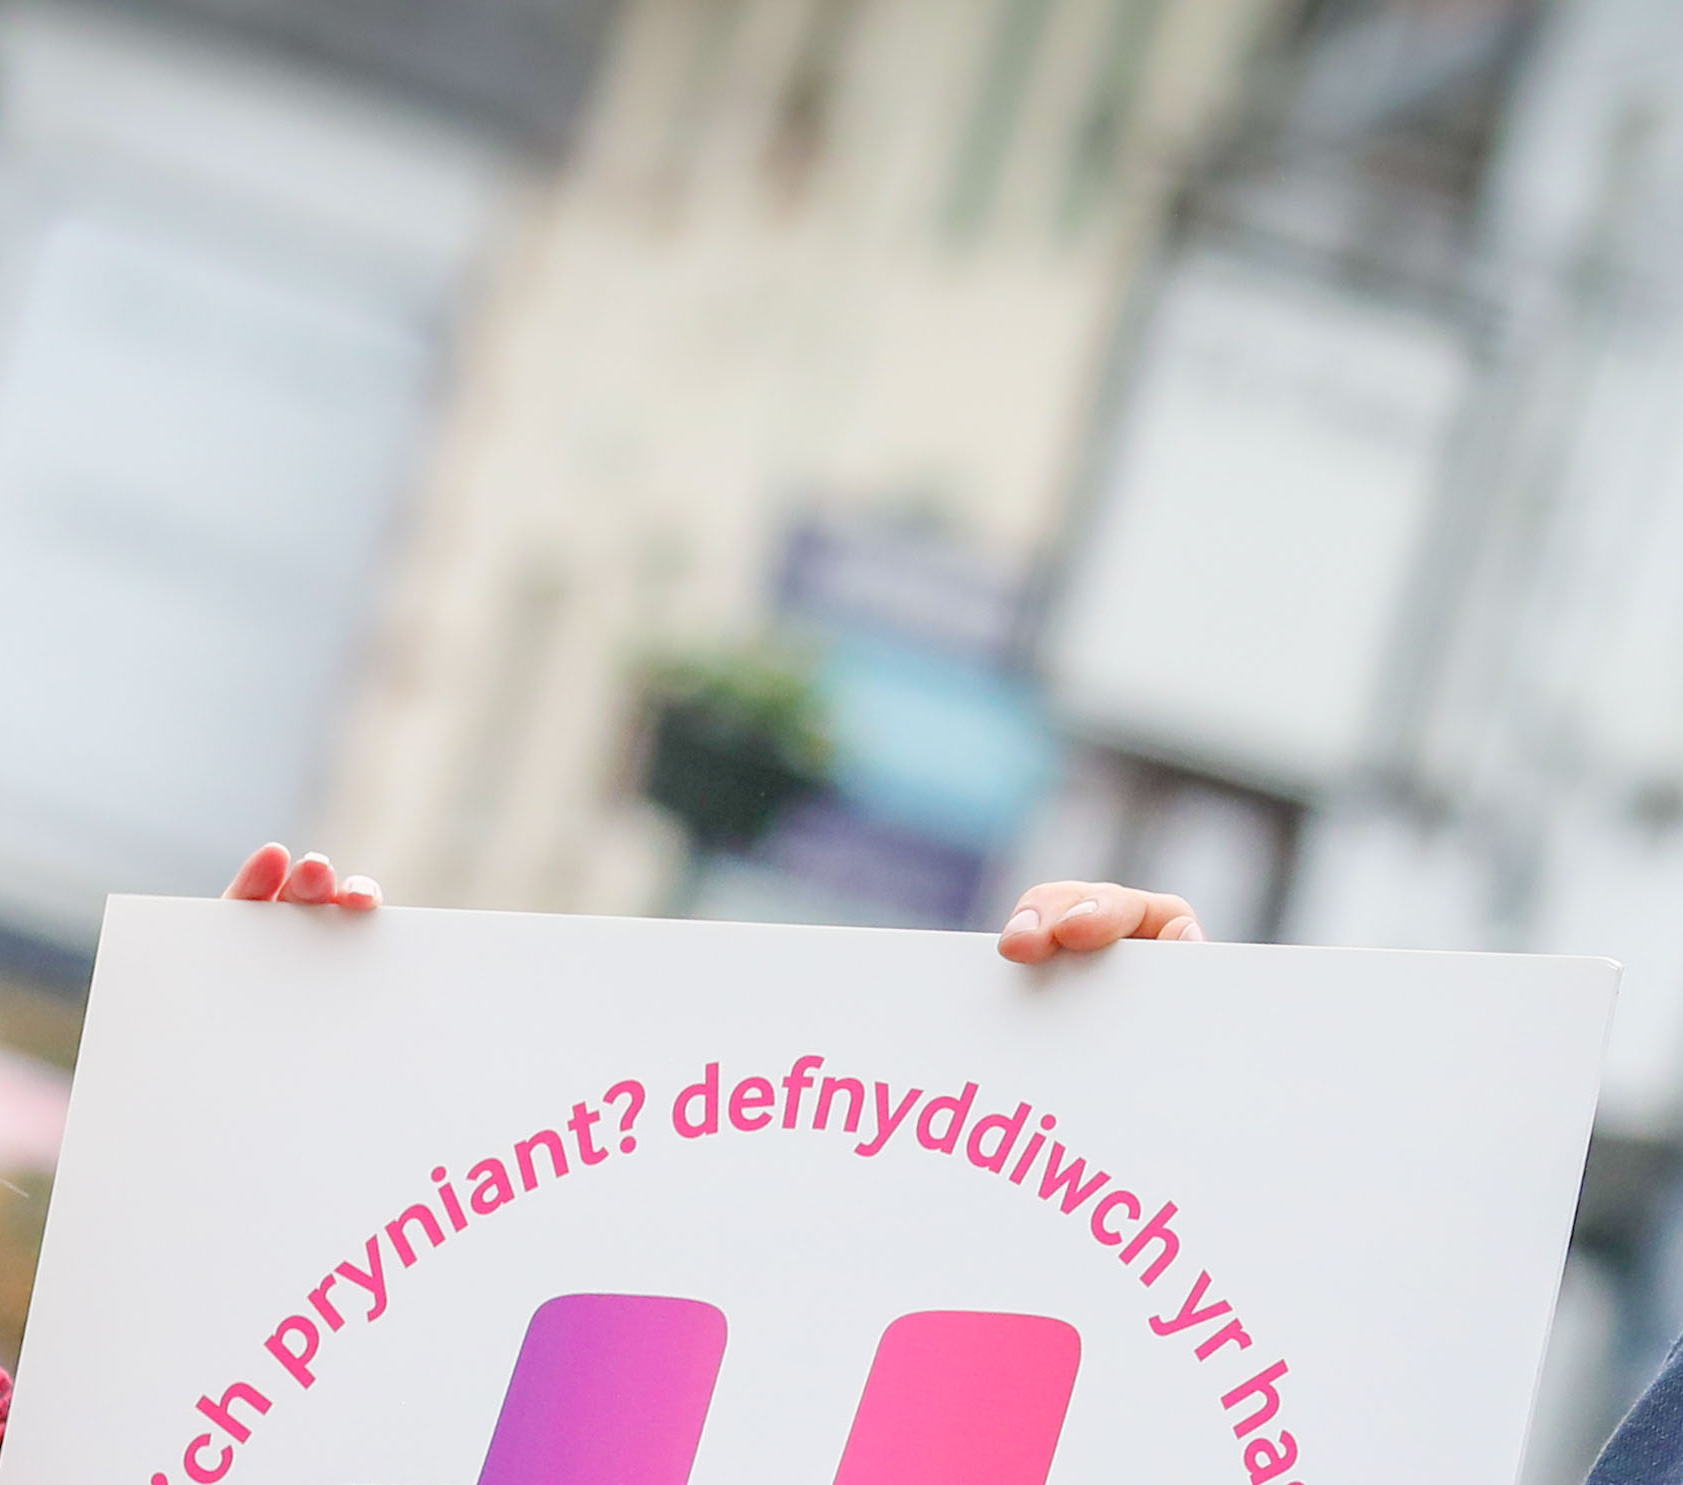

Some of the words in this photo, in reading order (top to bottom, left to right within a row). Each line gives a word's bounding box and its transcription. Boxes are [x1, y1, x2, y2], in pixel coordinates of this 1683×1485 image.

[265, 1080, 645, 1388] pryniant?
[673, 1056, 1179, 1286] defnyddiwch
[1149, 1271, 1252, 1360] yr
